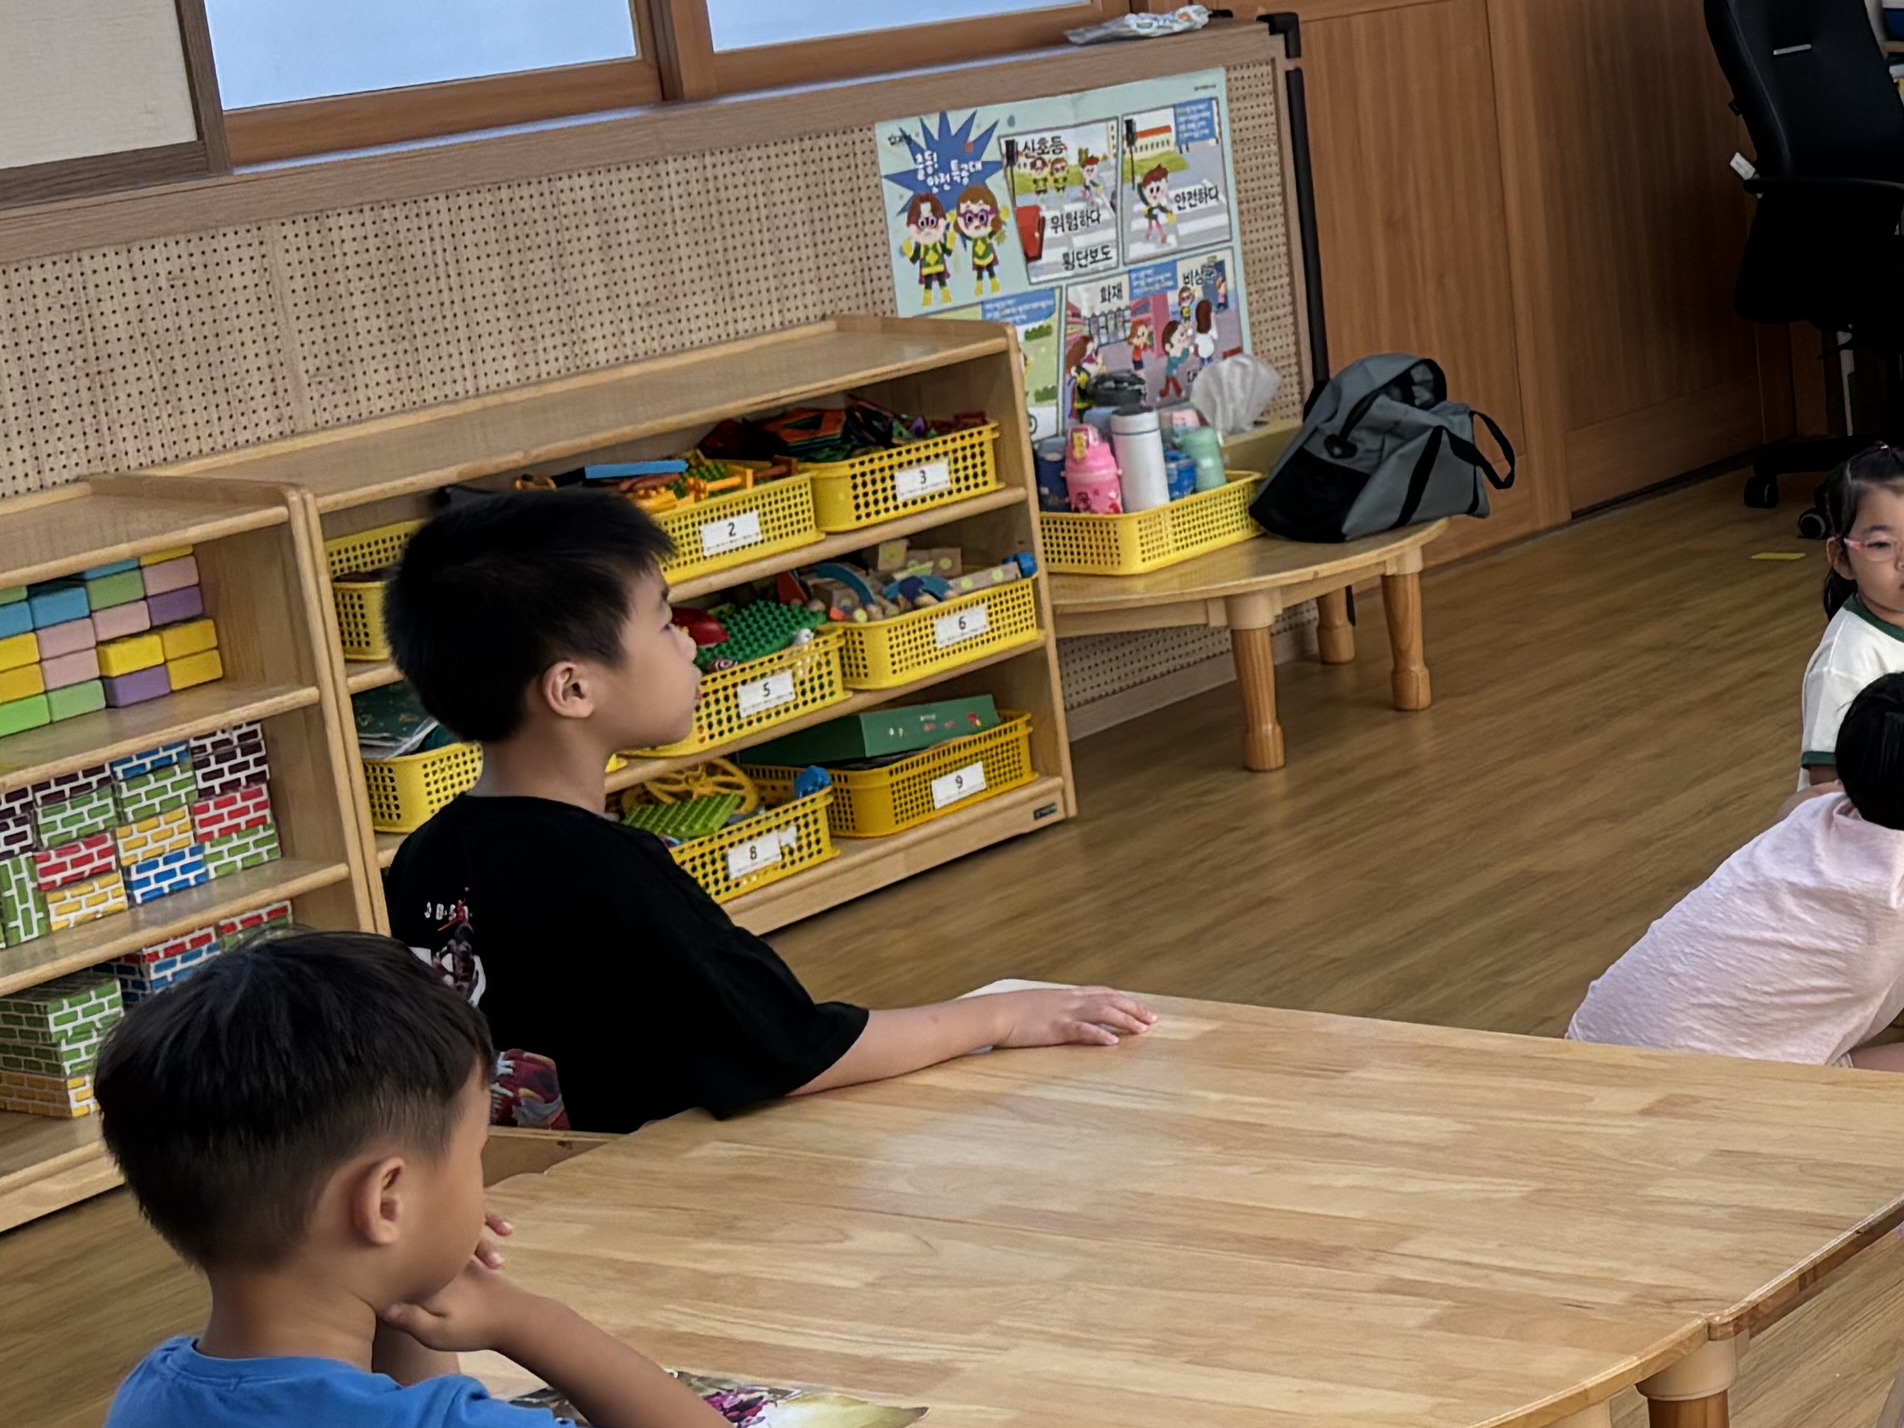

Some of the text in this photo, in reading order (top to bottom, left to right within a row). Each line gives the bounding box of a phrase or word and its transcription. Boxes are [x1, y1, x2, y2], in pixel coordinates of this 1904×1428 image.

[1022, 135, 1066, 159] 신호등
[926, 159, 983, 193] 안전 특공대
[1174, 185, 1219, 210] 안전하다
[1050, 209, 1102, 234] 위험하다
[1062, 244, 1113, 270] 횡단보도
[1100, 282, 1123, 304] 화재
[919, 469, 927, 484] 3
[728, 521, 736, 537] 2
[958, 616, 967, 630] 6
[762, 682, 771, 697] 5
[955, 775, 964, 789] 9
[749, 845, 758, 860] 8
